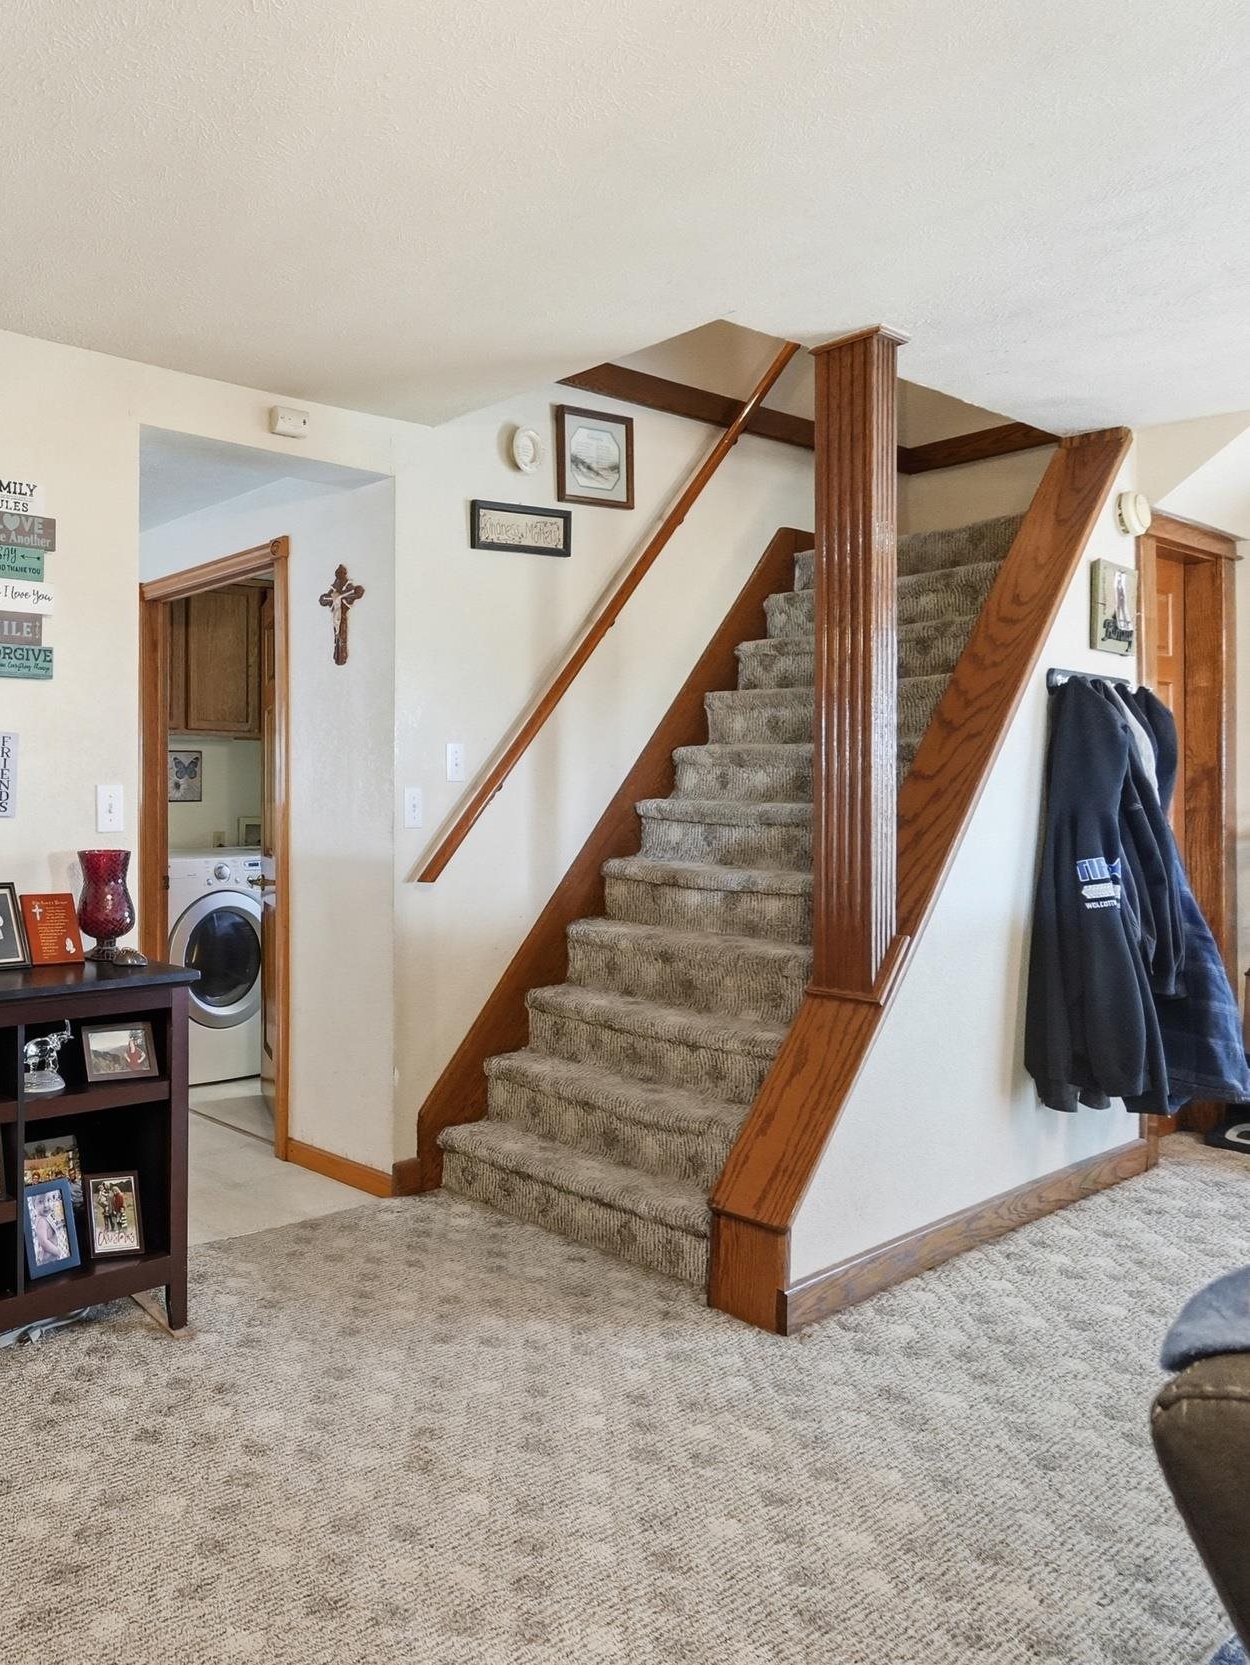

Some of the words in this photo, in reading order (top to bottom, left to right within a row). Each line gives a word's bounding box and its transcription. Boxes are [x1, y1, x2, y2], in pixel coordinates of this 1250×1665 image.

[9, 530, 51, 548] Another
[6, 564, 28, 574] THANK
[29, 565, 41, 575] YOU
[3, 585, 10, 596] I
[11, 586, 31, 600] love
